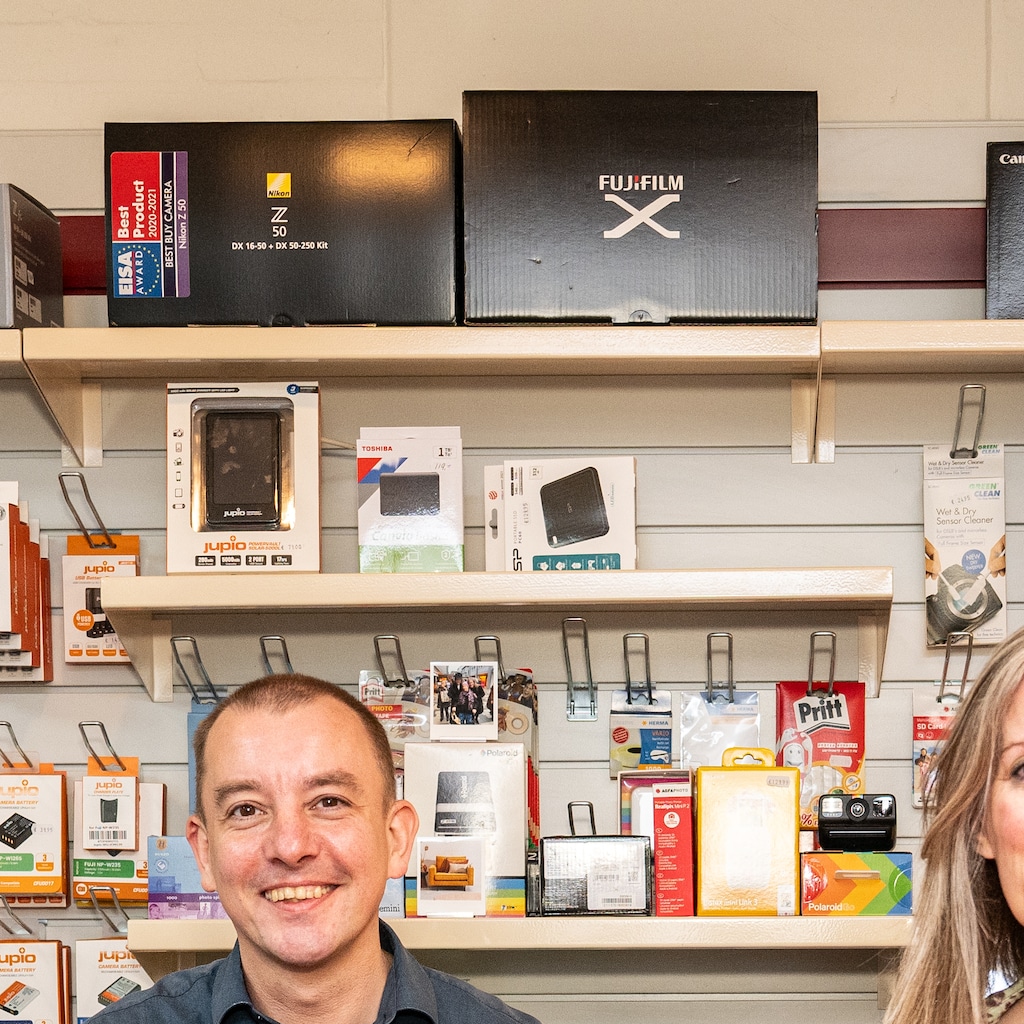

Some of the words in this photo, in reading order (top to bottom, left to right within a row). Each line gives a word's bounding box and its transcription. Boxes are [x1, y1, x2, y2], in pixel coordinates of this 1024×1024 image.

[133, 180, 145, 238] Product
[164, 180, 173, 225] CAMERA
[177, 199, 186, 211] 50
[148, 188, 157, 237] 2020-2021
[178, 213, 186, 222] Z
[118, 205, 130, 239] Best
[165, 226, 174, 244] BUY
[179, 223, 187, 249] Nikon
[272, 226, 287, 238] 50
[232, 242, 243, 250] DX
[245, 242, 267, 250] 16-50
[275, 242, 287, 250] DX
[289, 242, 315, 250] 50-250
[316, 241, 328, 250] Kit
[165, 245, 174, 268] BEST
[118, 251, 133, 296] EISA
[136, 250, 144, 295] AWARD
[438, 447, 444, 456] 1
[223, 507, 246, 517] jupio
[962, 508, 977, 517] Dry
[936, 517, 961, 525] Sensor
[964, 515, 994, 524] Cleaner
[203, 535, 247, 553] jupio
[513, 548, 522, 571] SP
[966, 553, 981, 561] NEW
[84, 561, 115, 574] jupio
[799, 699, 842, 723] Pritt
[486, 749, 518, 757] Polaroid
[95, 778, 122, 789] jupio
[808, 902, 843, 911] Polaroid
